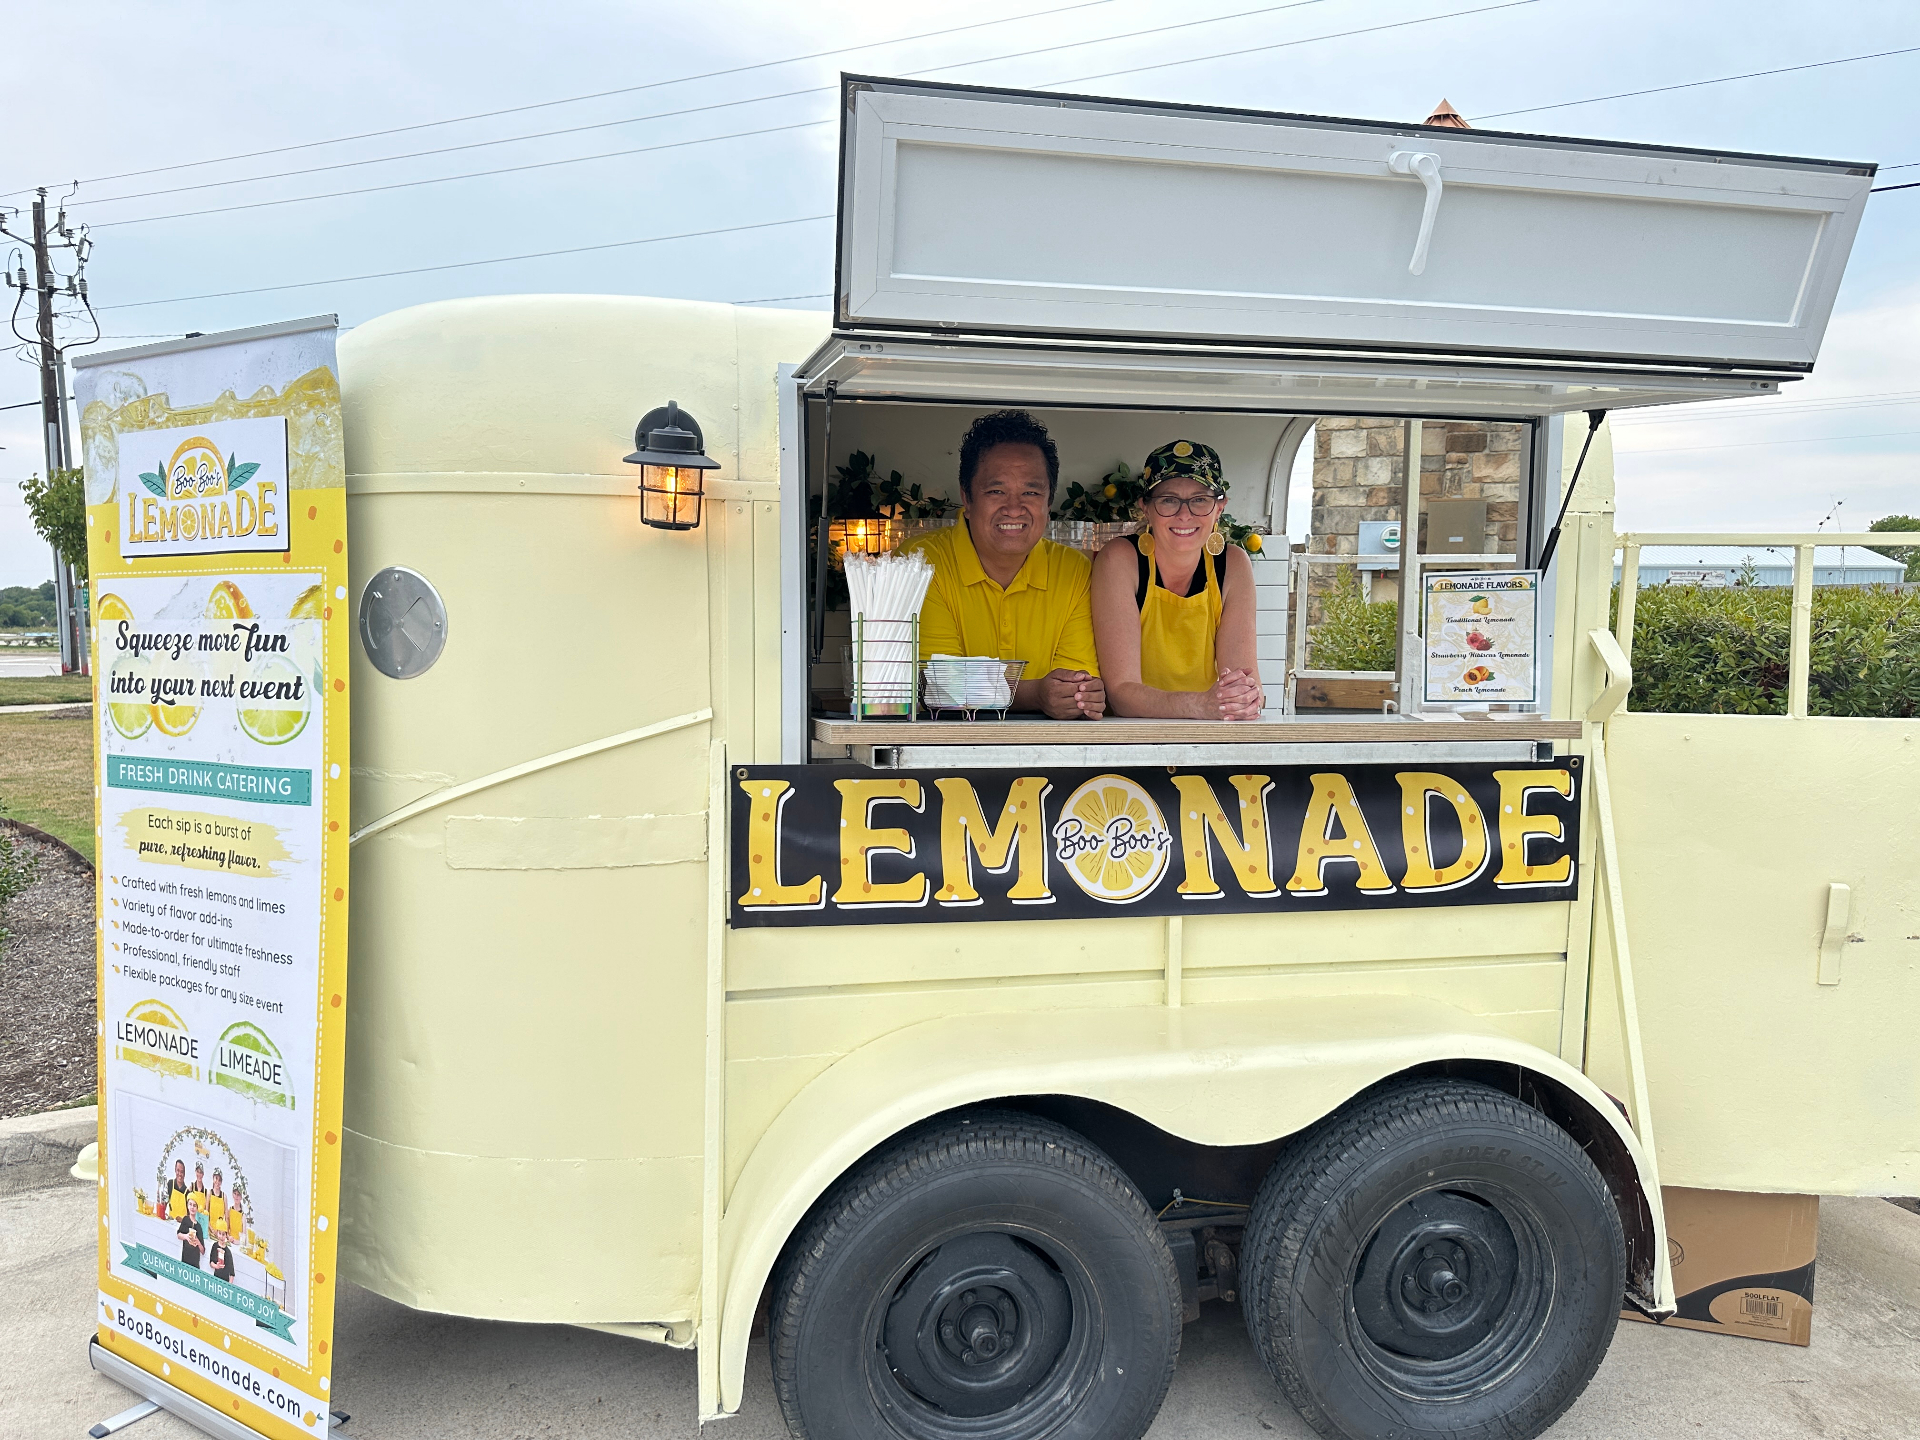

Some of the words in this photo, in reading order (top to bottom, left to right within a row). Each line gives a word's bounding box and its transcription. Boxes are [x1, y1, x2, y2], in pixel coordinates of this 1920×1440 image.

[173, 465, 195, 495] Boo
[196, 463, 222, 493] Boo's
[128, 482, 278, 543] LEMONADE
[1440, 582, 1485, 590] LEMONADE
[1486, 581, 1523, 589] FLAVORS
[1445, 616, 1482, 624] Traditional
[1484, 616, 1516, 625] Lemonade
[115, 620, 194, 661] Squeeze
[198, 633, 241, 652] more
[232, 622, 290, 662] fun
[1430, 651, 1467, 660] Strawberry
[1497, 651, 1531, 660] Lemonade
[110, 669, 147, 694] into
[150, 677, 196, 706] your
[200, 674, 236, 698] next
[239, 675, 305, 700] event
[1474, 686, 1507, 695] Lemonade
[119, 763, 163, 783] FRESH
[168, 767, 213, 788] DRINK
[216, 772, 292, 796] CATERING
[148, 813, 173, 830] Each
[176, 817, 191, 836] sip
[194, 818, 202, 833] is
[204, 823, 212, 835] a
[214, 821, 239, 839] burst
[240, 826, 252, 841] of
[738, 770, 1575, 912] LEMONADE
[1056, 818, 1104, 860] Boo
[1106, 817, 1170, 859] Boo's
[138, 840, 168, 855] pure,
[170, 843, 227, 868] refreshing
[227, 850, 261, 870] flavor.
[121, 875, 156, 892] Crafted
[158, 881, 178, 896] with
[180, 883, 204, 900] fresh
[206, 887, 237, 906] lemons
[238, 896, 254, 910] and
[256, 897, 286, 914] limes
[121, 897, 155, 917] Variety
[157, 903, 168, 916] of
[169, 905, 197, 921] flavor
[199, 911, 233, 928] add-ins
[122, 920, 189, 943] Made-to-order
[191, 932, 205, 946] for
[207, 936, 243, 955] ultimate
[245, 943, 293, 965] freshness
[123, 942, 181, 967] Professional,
[182, 953, 218, 976] friendly
[219, 963, 241, 978] staff
[123, 965, 157, 983] Flexible
[159, 974, 203, 994] packages
[204, 981, 218, 996] for
[220, 987, 237, 1004] any
[239, 991, 254, 1006] size
[256, 998, 283, 1014] event
[116, 1020, 199, 1060] LEMONADE
[219, 1046, 282, 1086] LIMEADE
[142, 1251, 175, 1275] QUENCH
[177, 1266, 201, 1287] YOUR
[203, 1278, 234, 1301] THIRST
[236, 1293, 255, 1311] FOR
[257, 1303, 275, 1320] JOY
[117, 1307, 301, 1419] BooBoosLemonade.com
